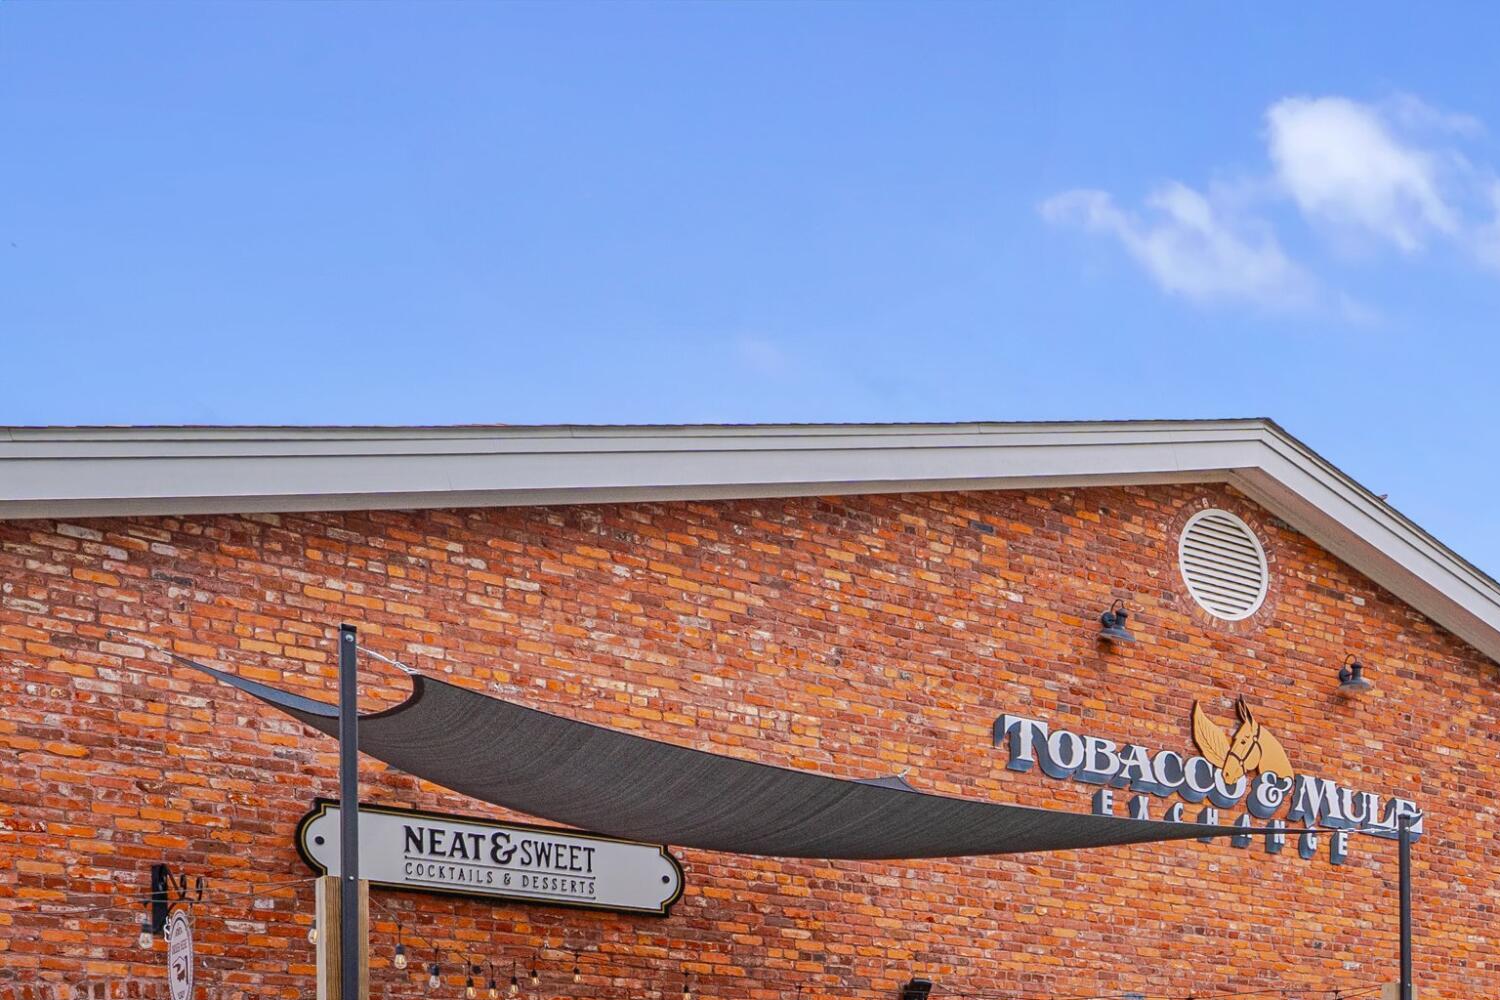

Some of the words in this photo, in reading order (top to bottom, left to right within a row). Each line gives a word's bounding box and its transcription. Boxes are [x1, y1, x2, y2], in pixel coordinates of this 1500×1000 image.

[1000, 714, 1248, 801] TOBACCO
[1255, 771, 1293, 810] &
[1294, 773, 1424, 836] MULE
[403, 824, 486, 861] NEAT
[489, 831, 518, 865] &
[519, 839, 596, 874] SWEET
[405, 862, 494, 885] COCKTAILS
[503, 872, 511, 885] &
[521, 874, 596, 895] DESSERTS
